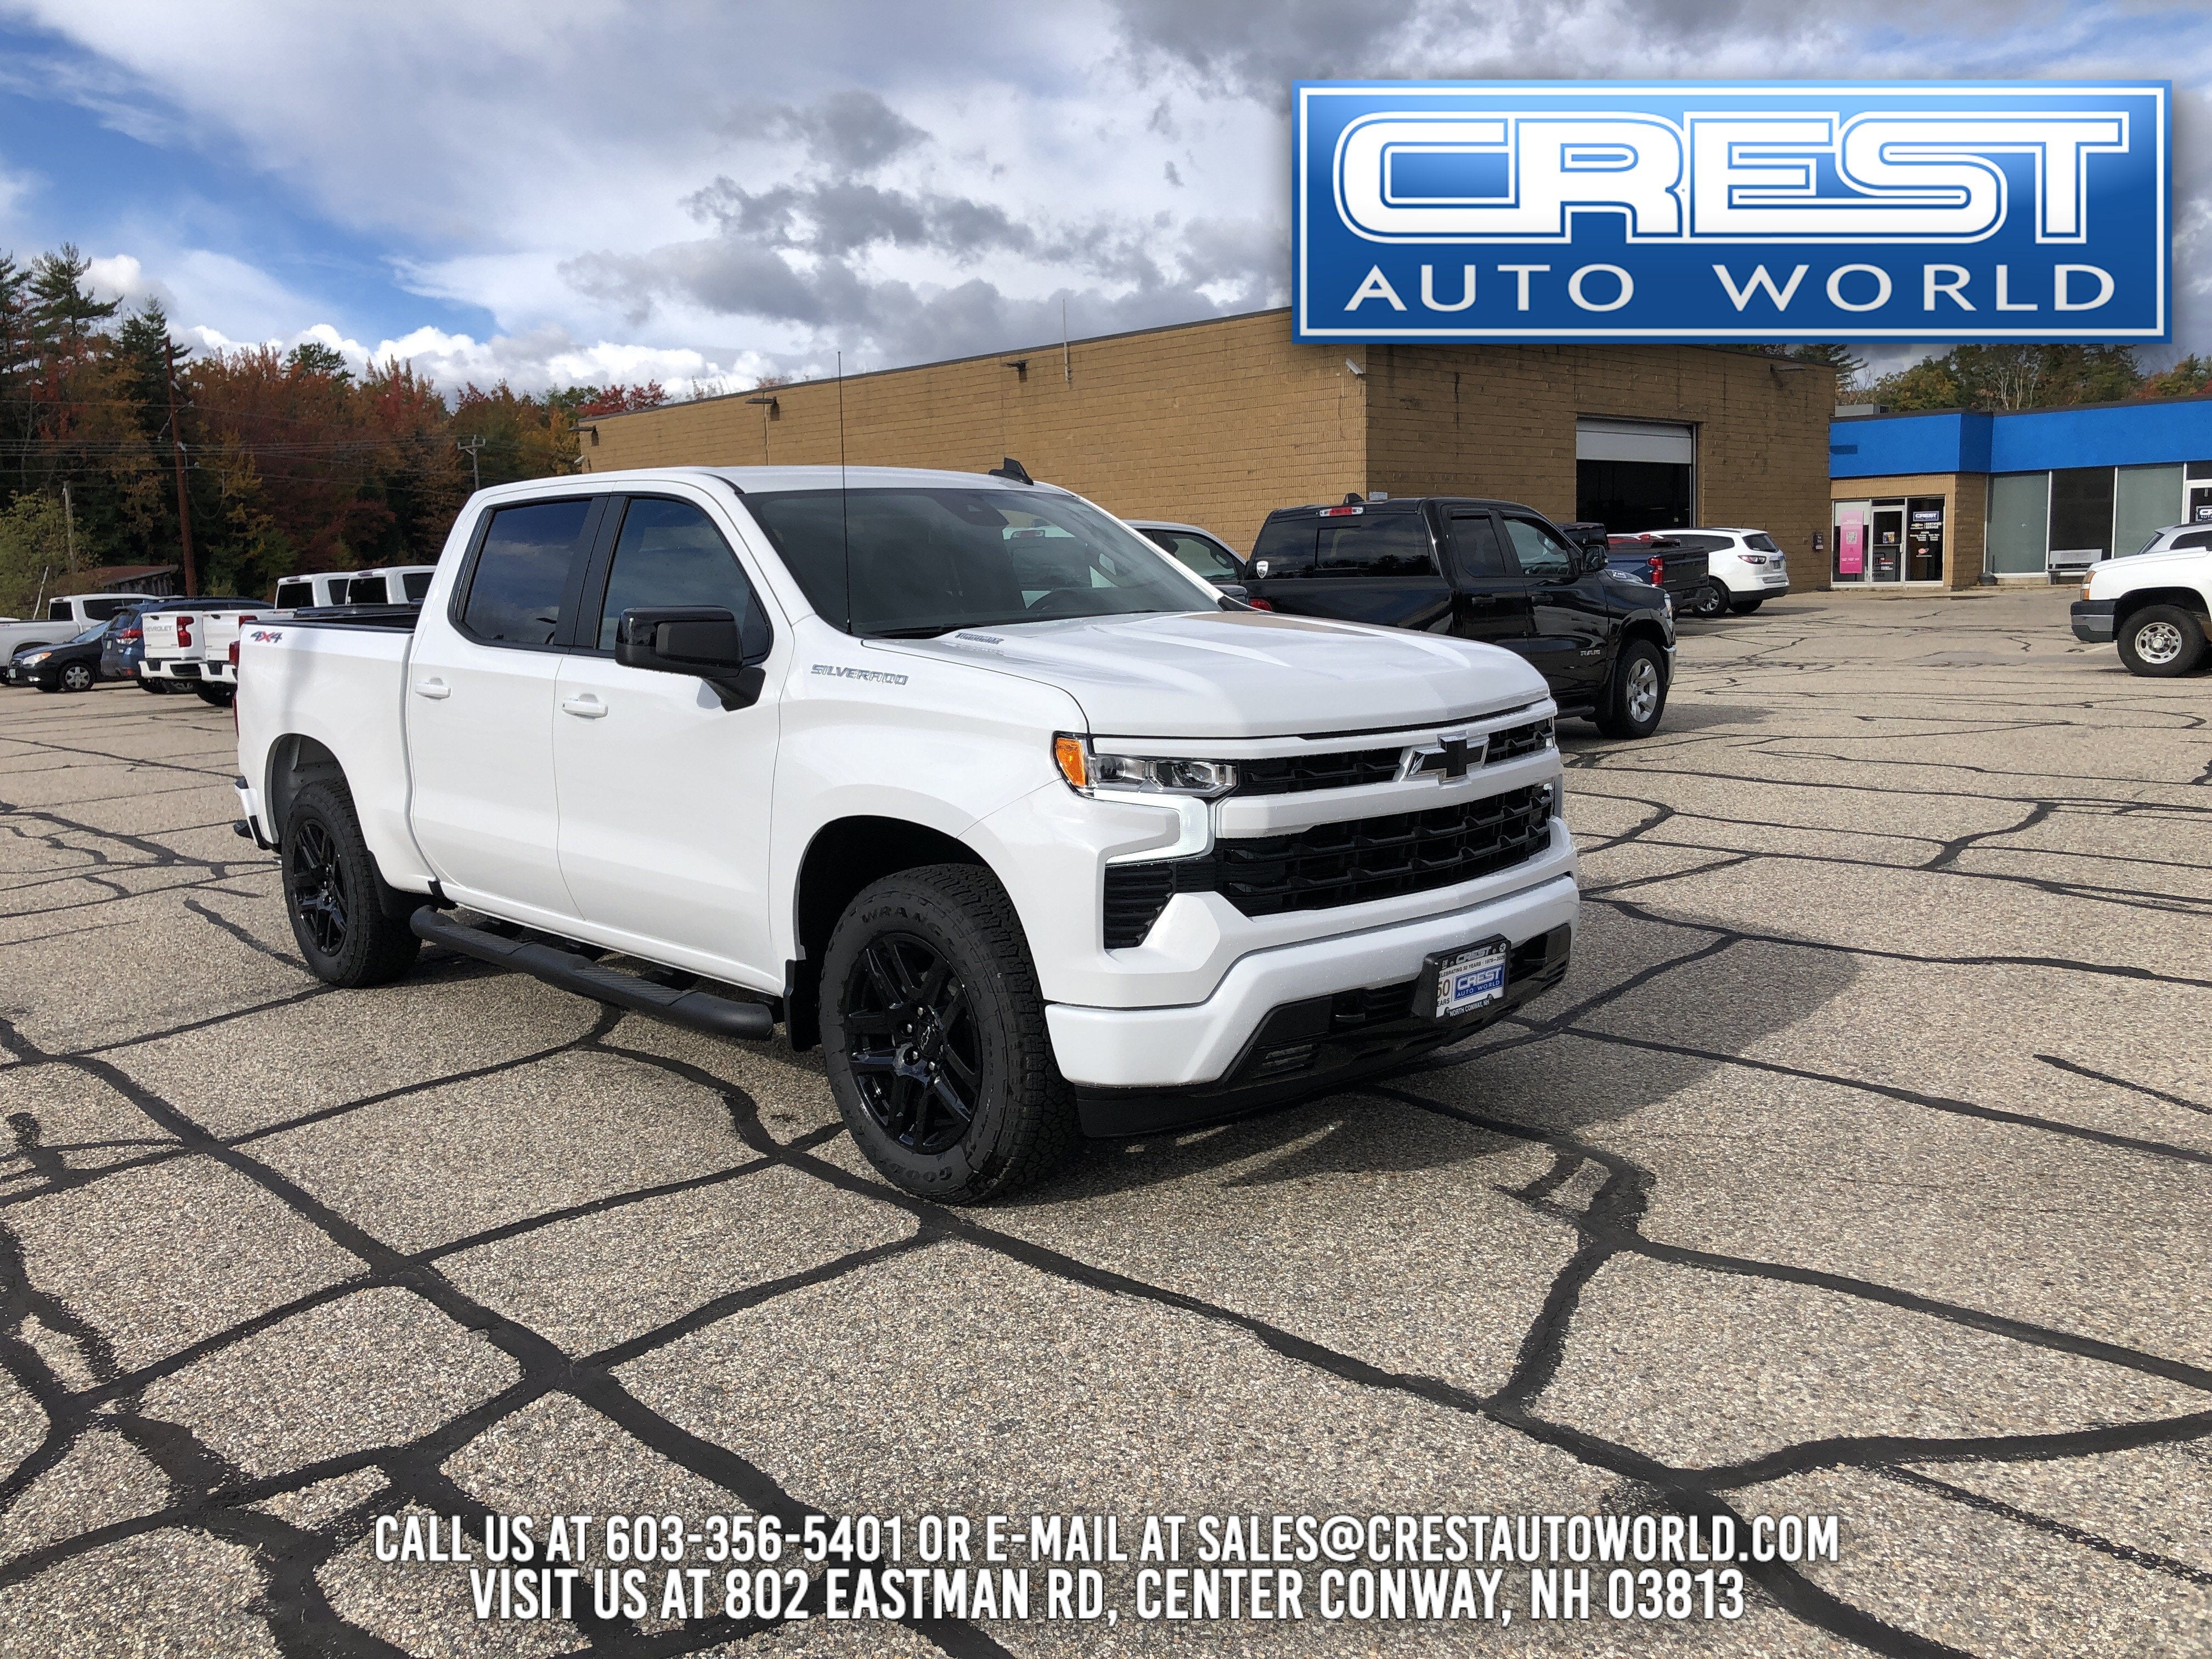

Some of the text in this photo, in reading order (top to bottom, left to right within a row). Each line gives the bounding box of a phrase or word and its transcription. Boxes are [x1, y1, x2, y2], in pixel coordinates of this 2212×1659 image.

[810, 663, 910, 686] SILVERADO
[1456, 946, 1492, 964] CREST
[1438, 967, 1463, 978] ELEBRATING
[1457, 967, 1502, 990] CREST
[1457, 980, 1500, 998] AUTO WORLD
[1437, 998, 1450, 1007] EARS
[1449, 1007, 1465, 1017] NORTH
